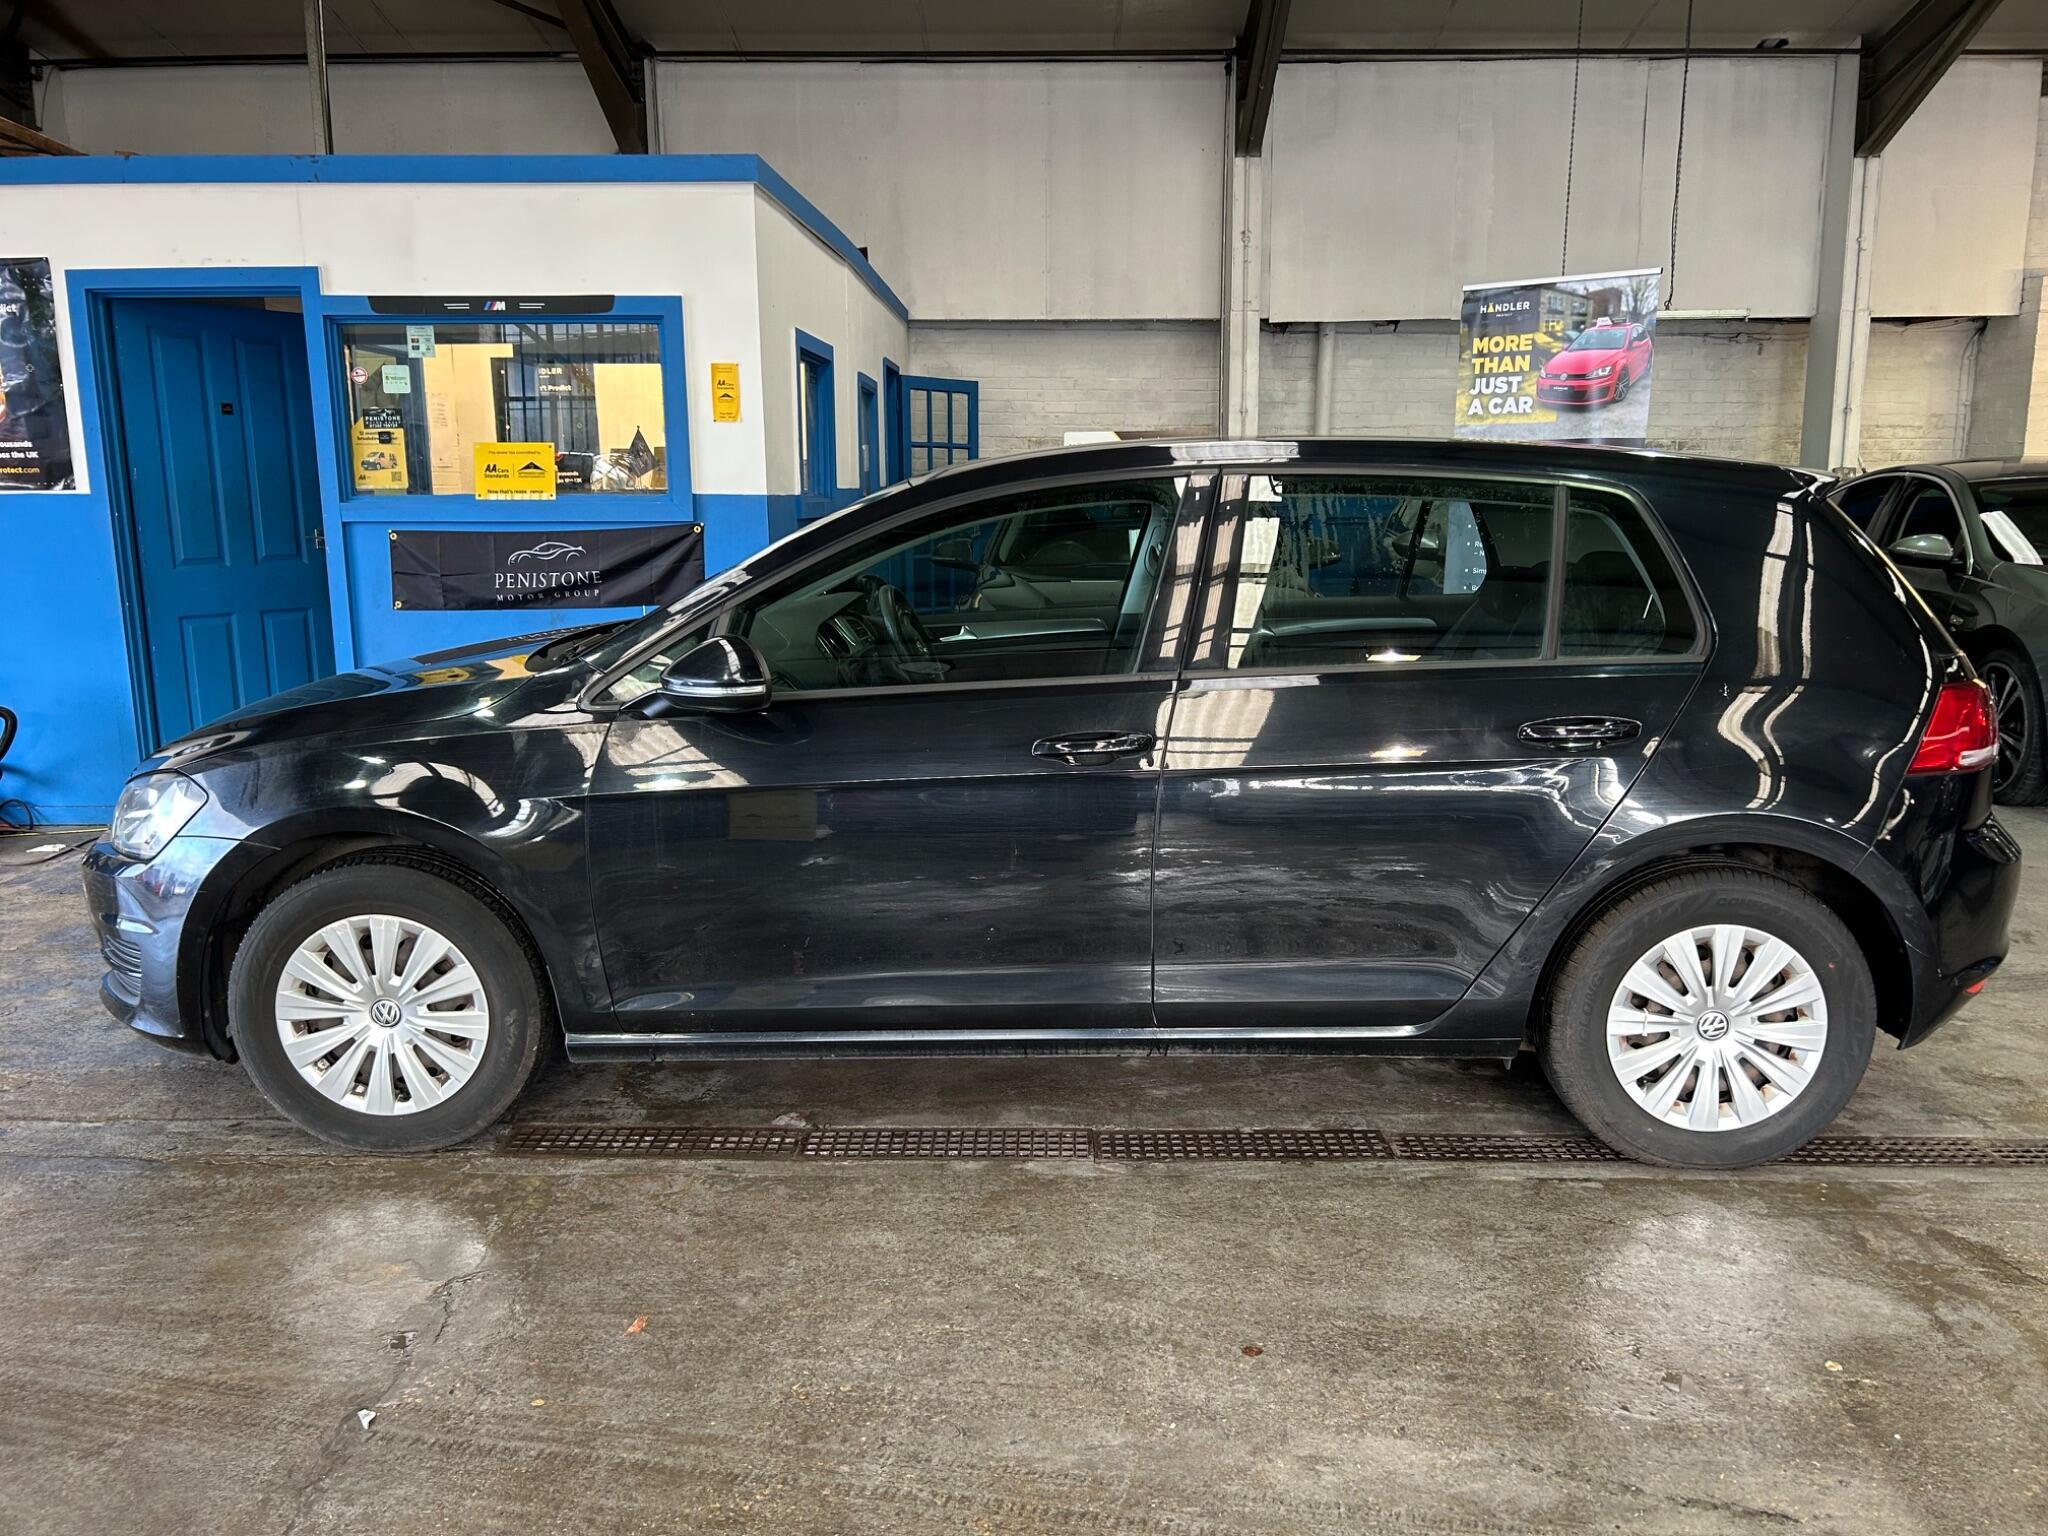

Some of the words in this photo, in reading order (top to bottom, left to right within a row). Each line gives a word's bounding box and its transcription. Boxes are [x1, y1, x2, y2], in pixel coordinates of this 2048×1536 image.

[1472, 334, 1534, 355] MORE
[1472, 354, 1531, 375] THAN
[1469, 375, 1522, 395] JUST
[1467, 398, 1483, 416] A
[1488, 396, 1534, 414] CAR
[484, 464, 497, 473] AA
[495, 571, 602, 589] PENISTONE
[496, 593, 544, 601] MOTOR
[554, 589, 600, 598] GROUP
